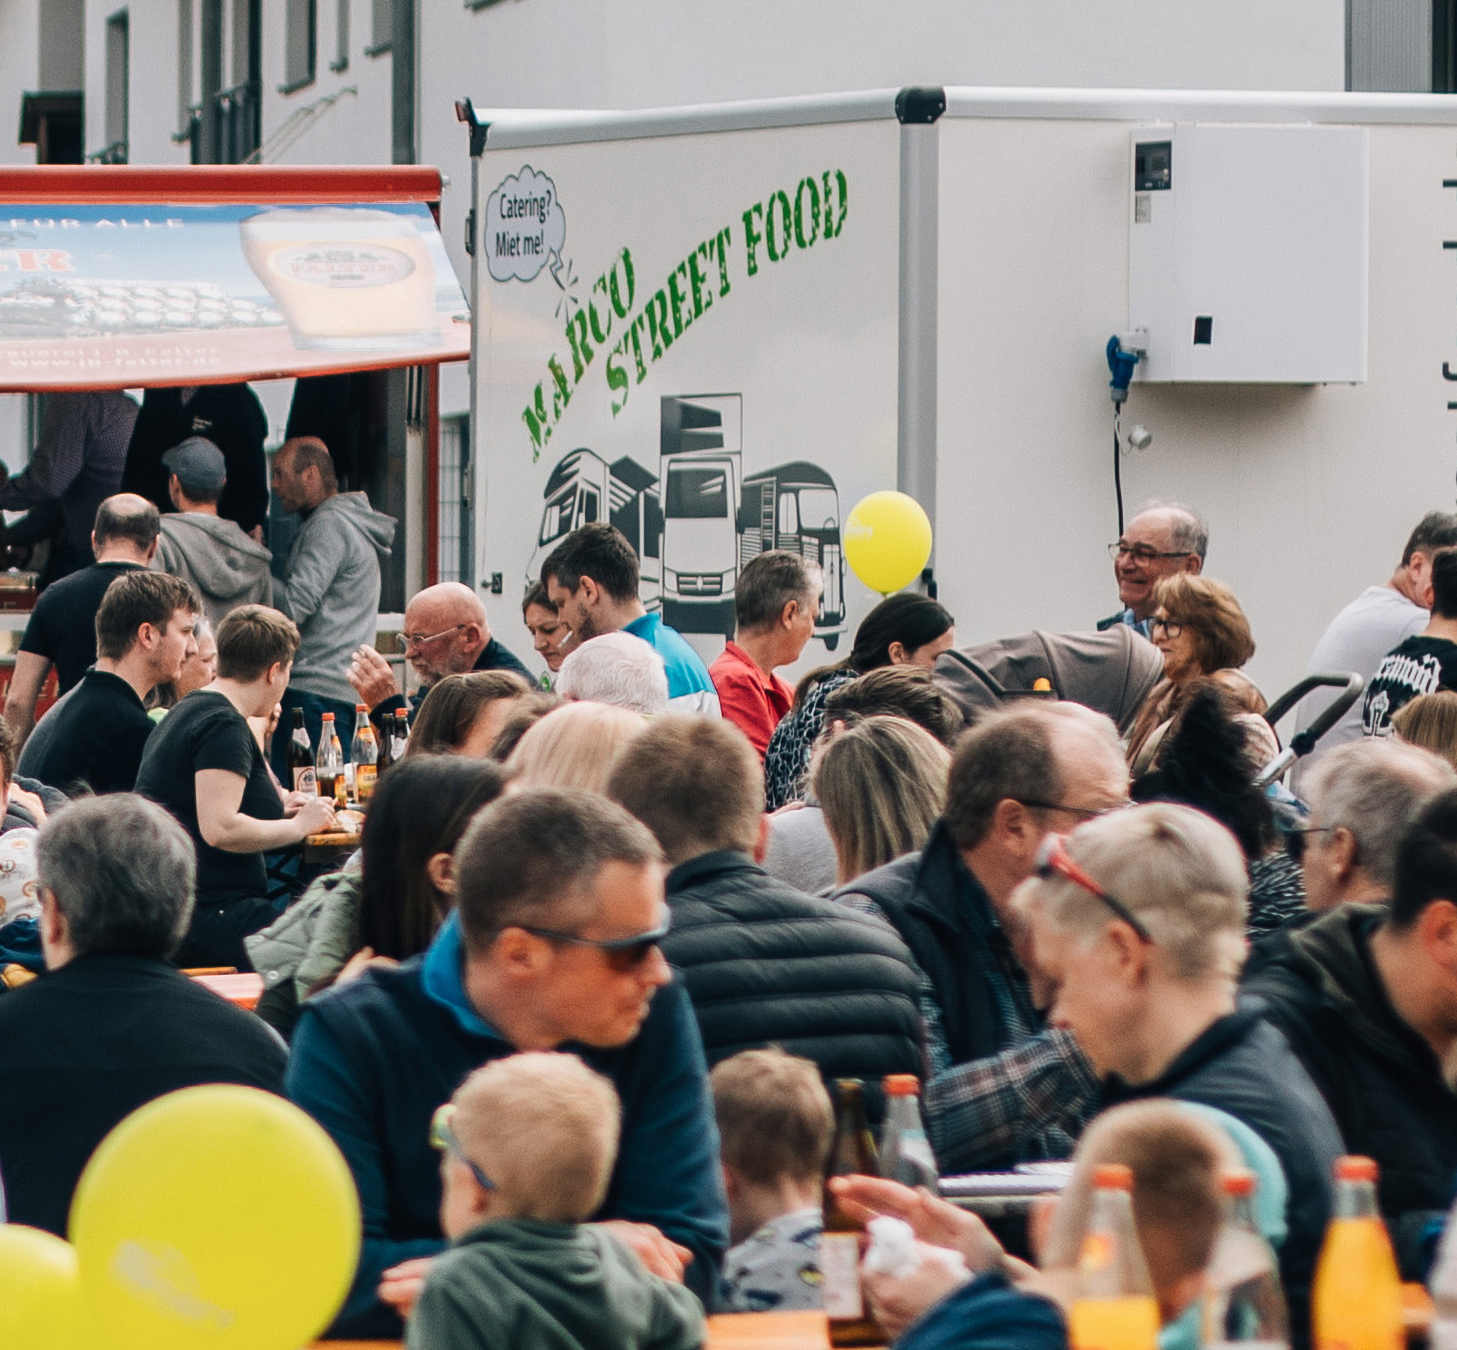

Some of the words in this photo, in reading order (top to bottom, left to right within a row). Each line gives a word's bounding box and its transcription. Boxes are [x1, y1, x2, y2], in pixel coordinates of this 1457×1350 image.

[95, 217, 185, 228] ALLE
[499, 189, 552, 224] Catering?
[495, 232, 521, 257] Miet
[523, 229, 545, 256] me!
[605, 227, 732, 419] STREET
[742, 169, 848, 277] FOOD
[521, 247, 635, 463] MARCO
